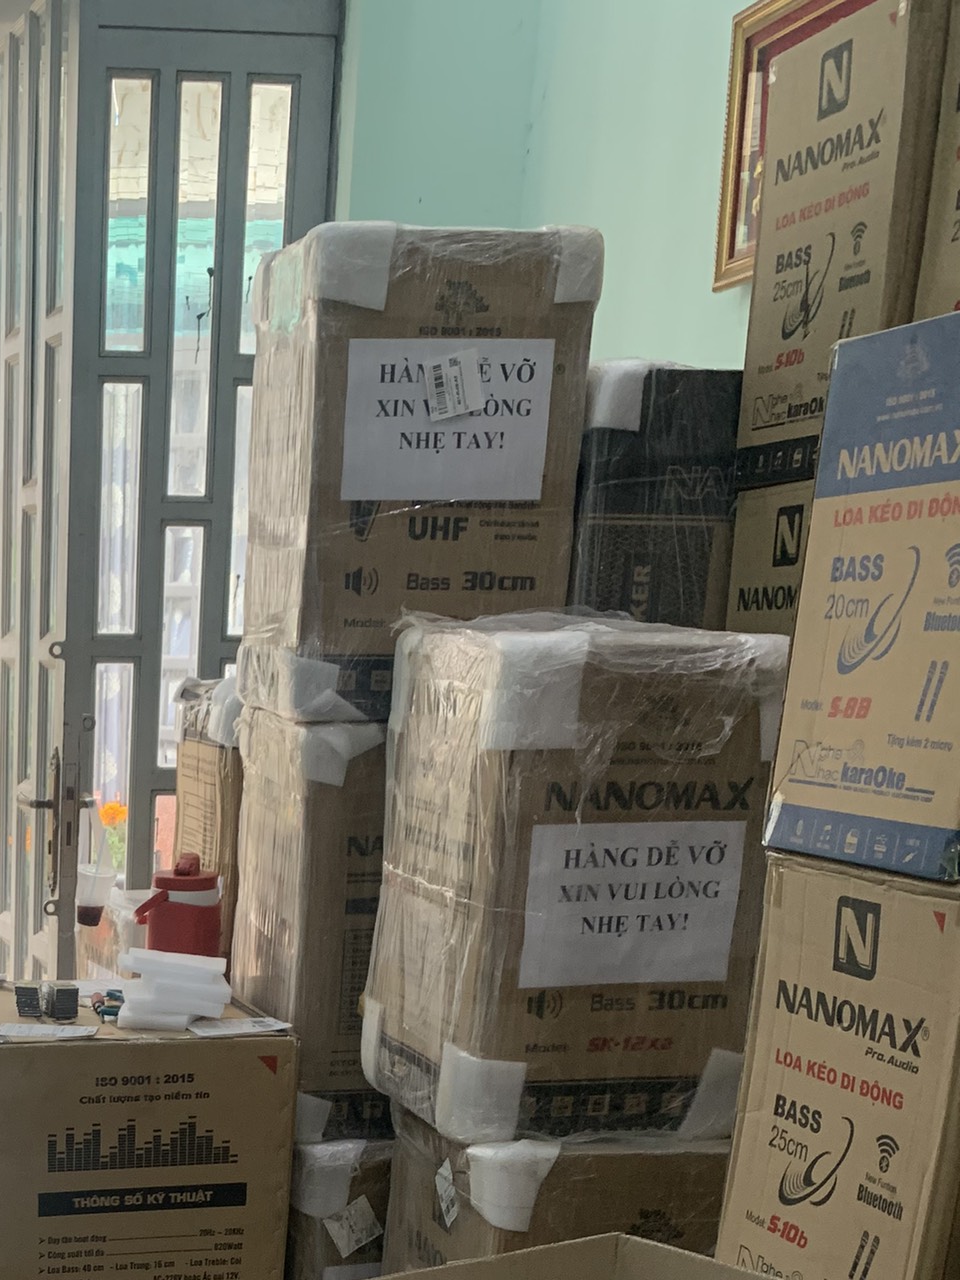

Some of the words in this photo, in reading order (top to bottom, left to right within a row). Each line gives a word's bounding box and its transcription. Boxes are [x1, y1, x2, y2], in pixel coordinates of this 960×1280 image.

[775, 108, 884, 186] NANOMAX
[775, 215, 796, 231] LOA
[775, 244, 812, 274] BASS
[773, 279, 802, 302] 25cm
[500, 358, 537, 384] VỠ
[376, 399, 415, 418] XIN
[399, 432, 446, 454] NHẸ
[452, 432, 506, 450] TAY!
[834, 506, 864, 528] LOA
[868, 498, 903, 525] KÉO
[907, 501, 923, 520] DI
[408, 516, 470, 541] UHF
[406, 572, 451, 591] Bass
[461, 571, 537, 592] 30cm
[830, 554, 884, 583] BASS
[824, 594, 870, 620] 20cm
[841, 762, 907, 790] karaOke
[544, 777, 754, 812] NANOMAX
[563, 844, 639, 870] HÀNG
[646, 840, 680, 867] DỄ
[687, 840, 728, 866] VỠ
[558, 884, 600, 903] XIN
[607, 882, 649, 901] VUI
[653, 876, 720, 900] LÒNG
[581, 914, 628, 937] NHẸ
[636, 913, 689, 934] TAY!
[589, 993, 636, 1012] Bass
[648, 990, 729, 1012] 30cm
[775, 979, 926, 1058] NANOMAX
[95, 1076, 118, 1087] ISO
[121, 1075, 151, 1087] 9001
[163, 1073, 195, 1085] 2015
[775, 1047, 803, 1073] LOA
[806, 1059, 838, 1085] KÉO
[840, 1073, 856, 1093] DI
[859, 1079, 905, 1110] ĐỘNG
[773, 1094, 823, 1134] BASS
[768, 1125, 809, 1163] 25cm
[72, 1196, 121, 1209] THÔNG
[124, 1192, 143, 1206] SỐ
[168, 1189, 214, 1206] THUẬT
[857, 1183, 904, 1222] Bluetooth
